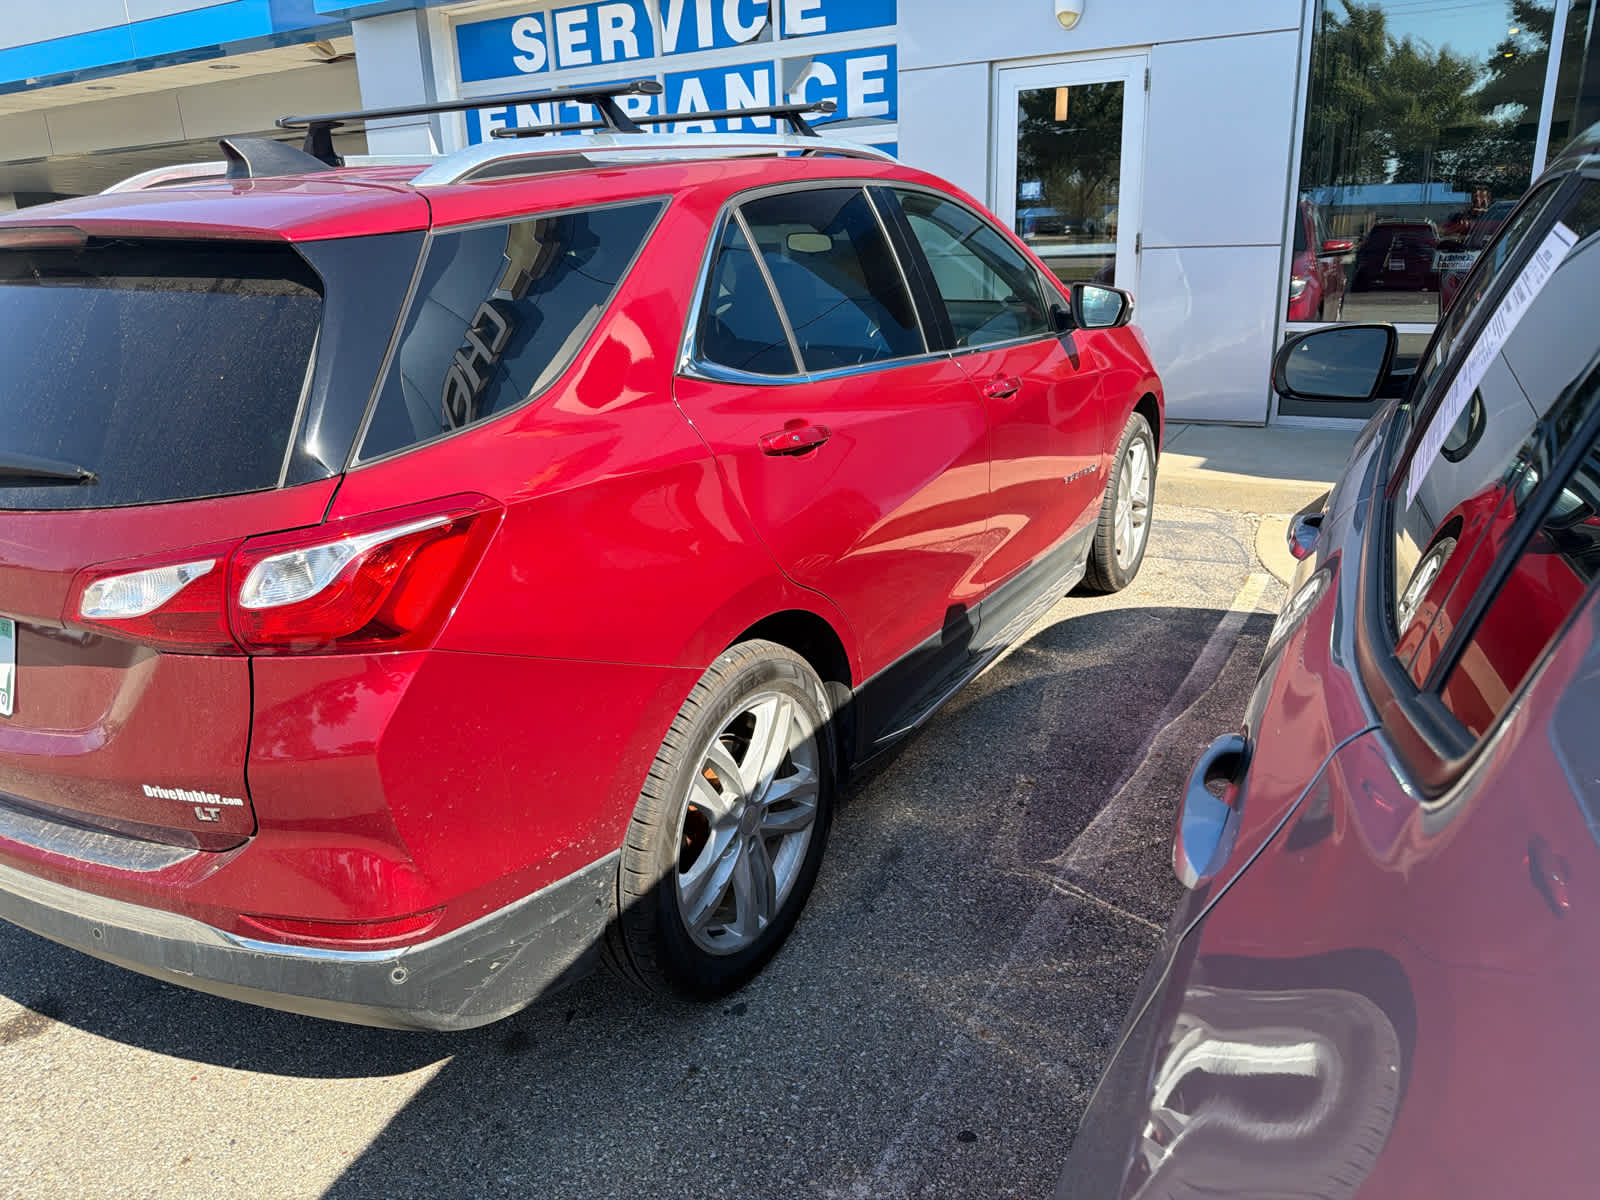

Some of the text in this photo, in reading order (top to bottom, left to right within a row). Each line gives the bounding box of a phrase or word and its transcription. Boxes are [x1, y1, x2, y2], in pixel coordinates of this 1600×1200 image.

[511, 0, 827, 73] SERVICE
[142, 784, 244, 806] DriveHubler.com
[194, 806, 221, 822] LT
